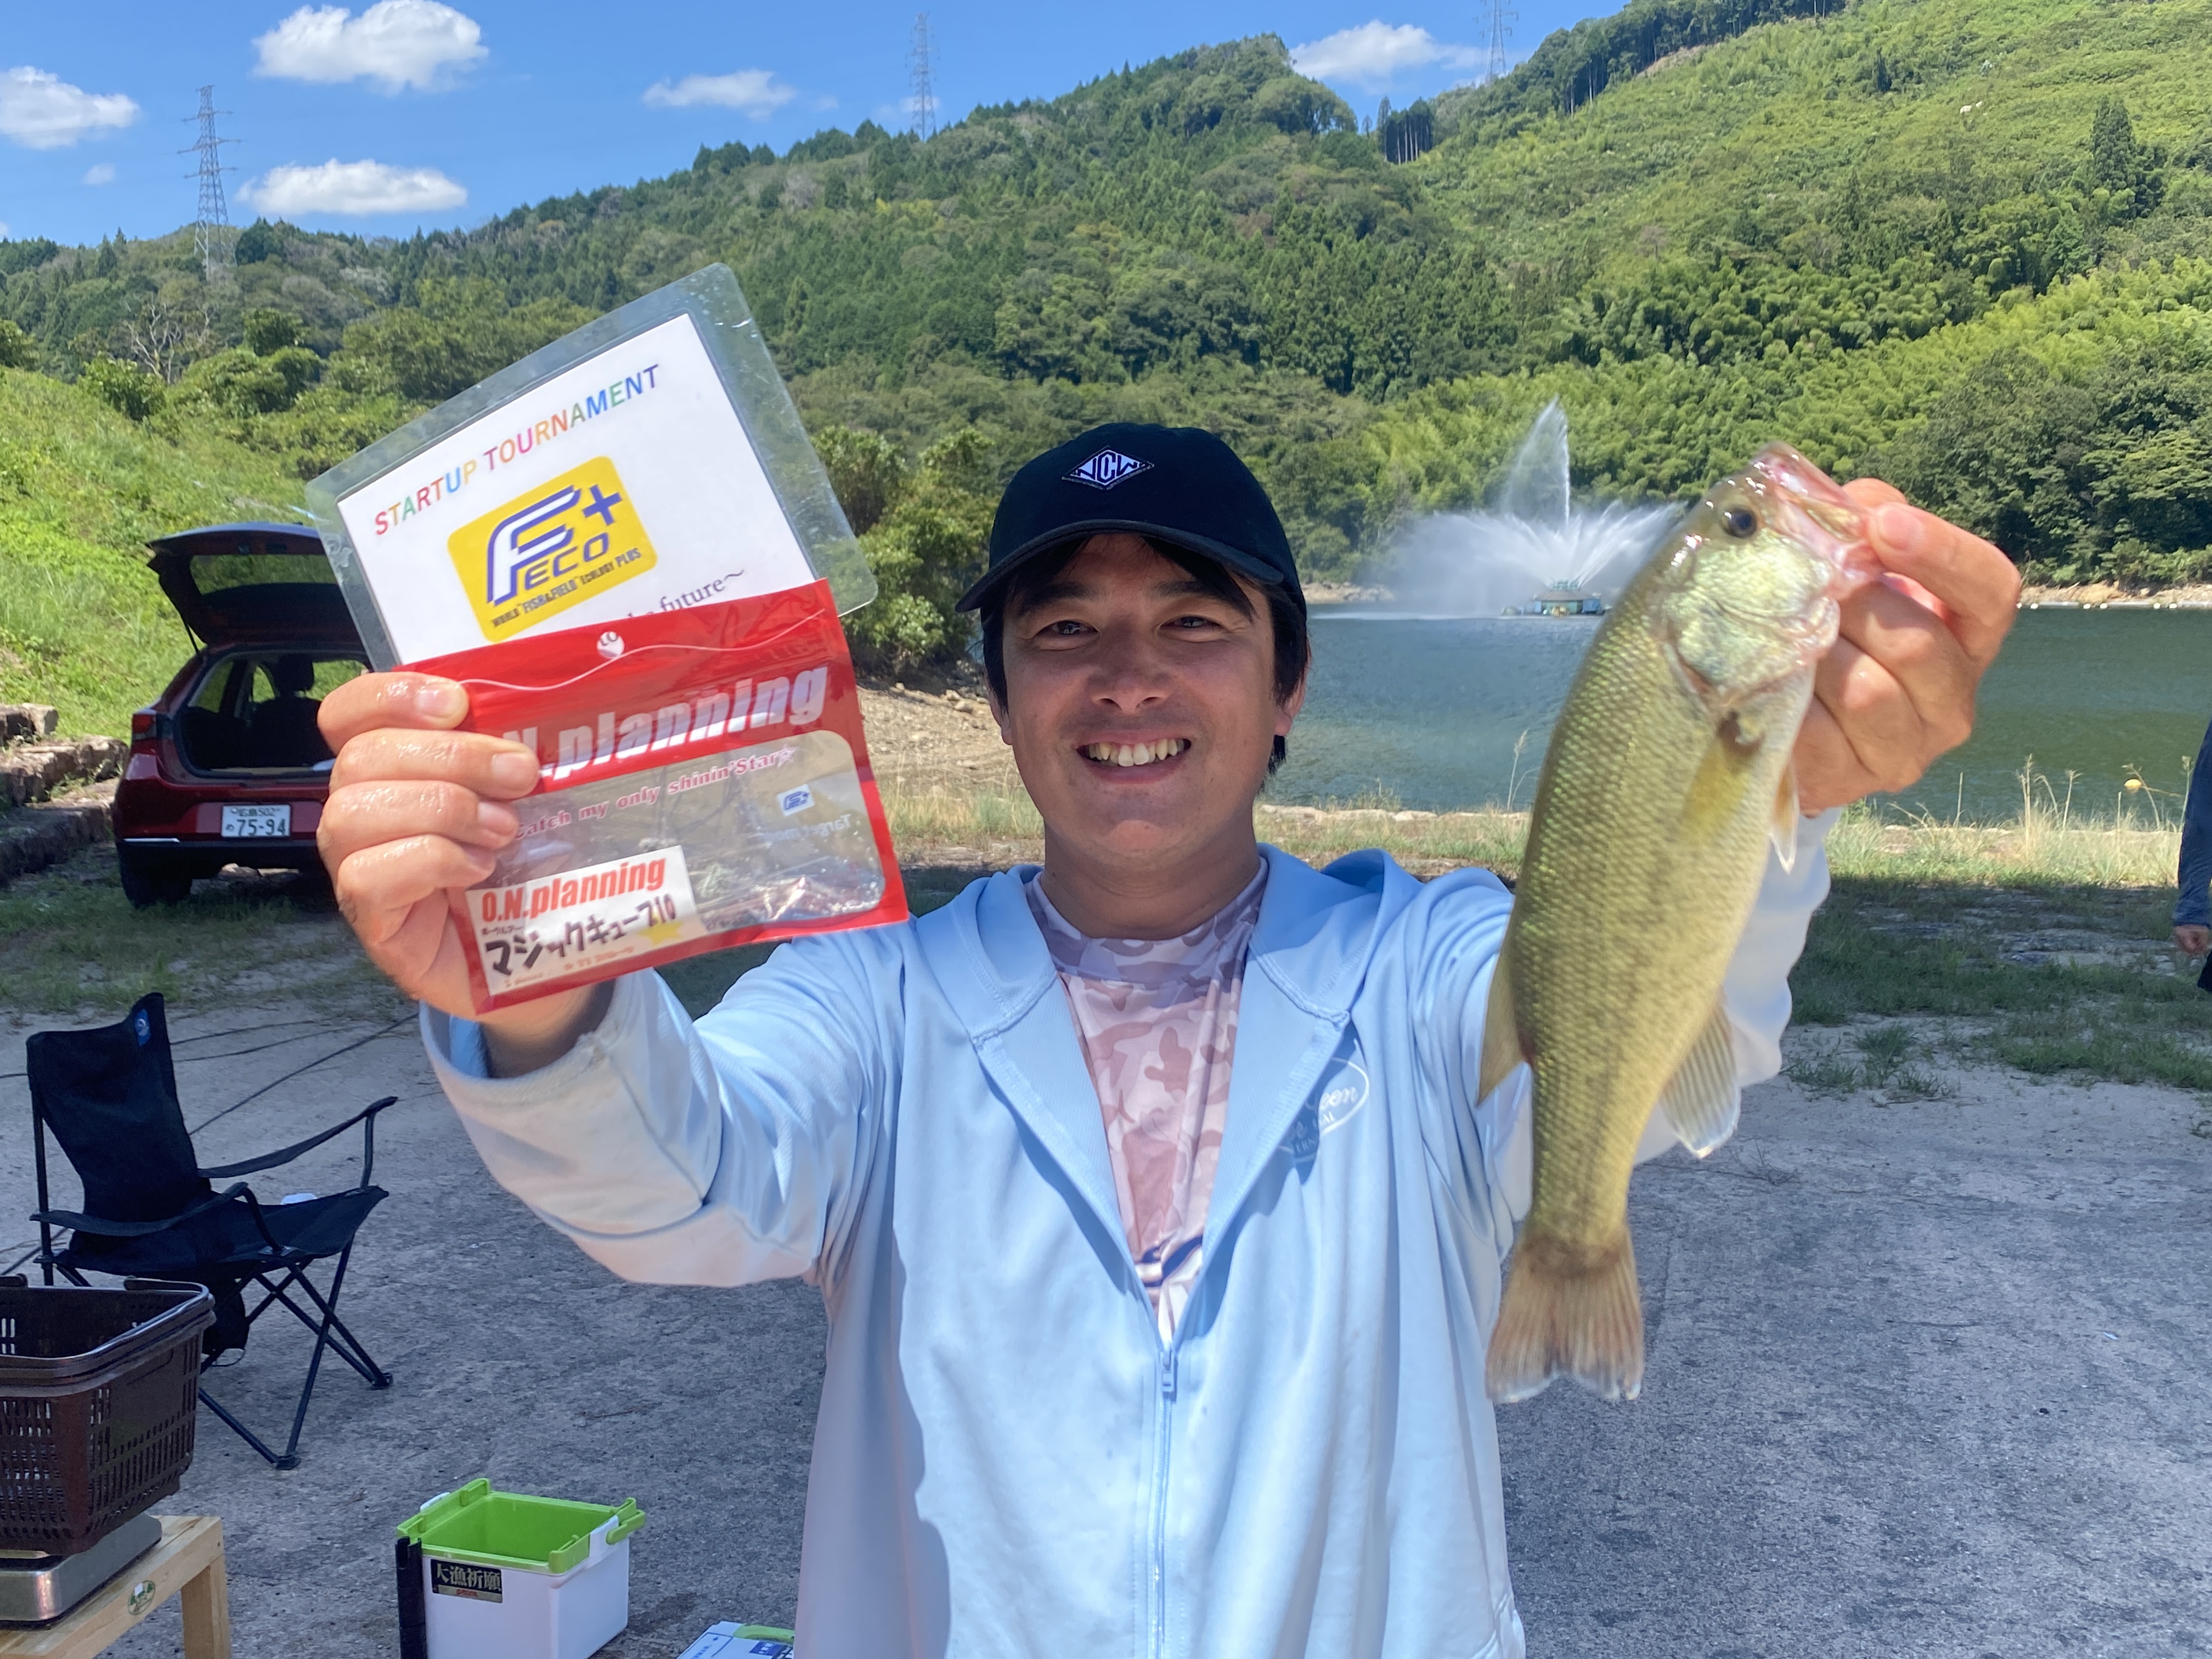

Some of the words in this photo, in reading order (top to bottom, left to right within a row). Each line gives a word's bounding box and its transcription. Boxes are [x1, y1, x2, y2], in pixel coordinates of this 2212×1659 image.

[375, 459, 477, 535] STARTUP
[483, 363, 658, 471] TOURNAMENT
[614, 547, 642, 567] PLUS
[579, 800, 609, 821] my
[616, 785, 660, 810] only
[236, 818, 286, 836] 75-94
[482, 857, 667, 923] O.N.planning
